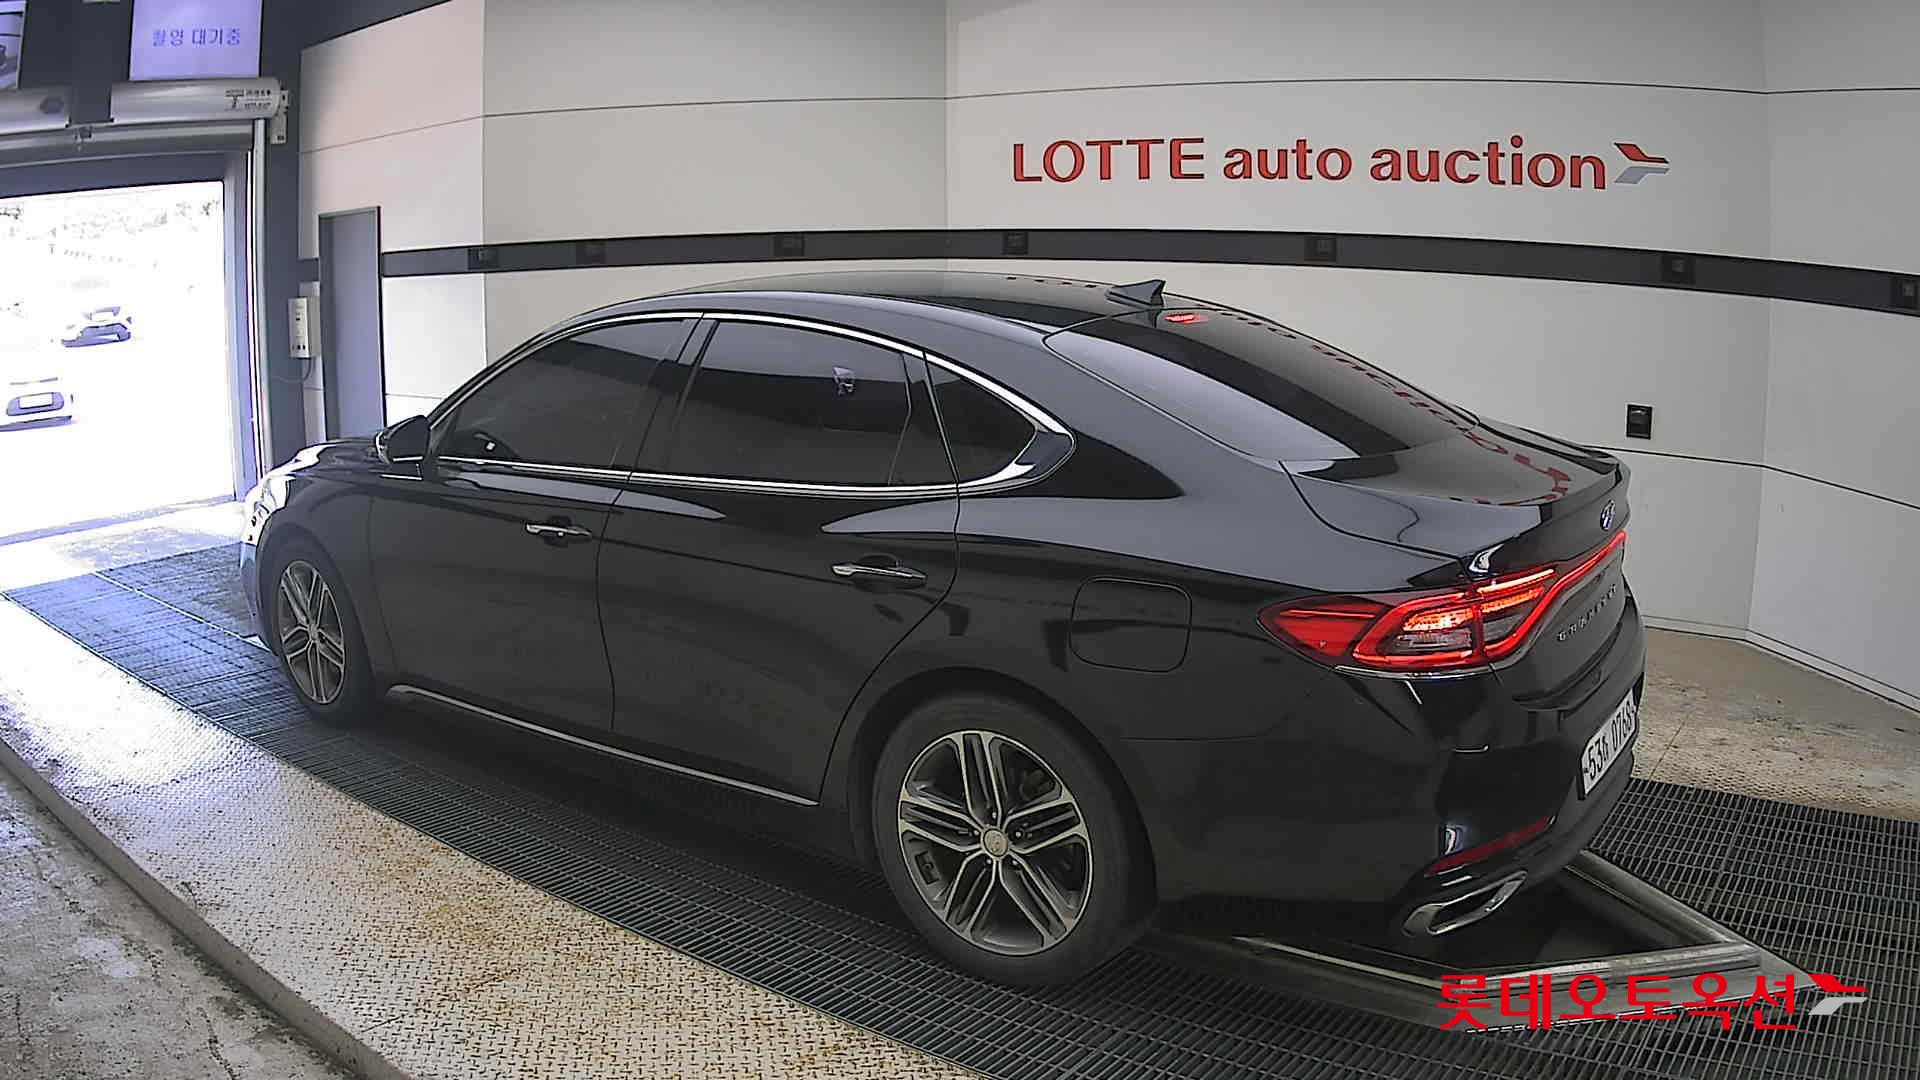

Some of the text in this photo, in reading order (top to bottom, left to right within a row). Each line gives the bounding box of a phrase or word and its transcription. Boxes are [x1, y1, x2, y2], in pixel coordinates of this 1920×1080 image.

[1013, 134, 1607, 190] LOTTE auto auction
